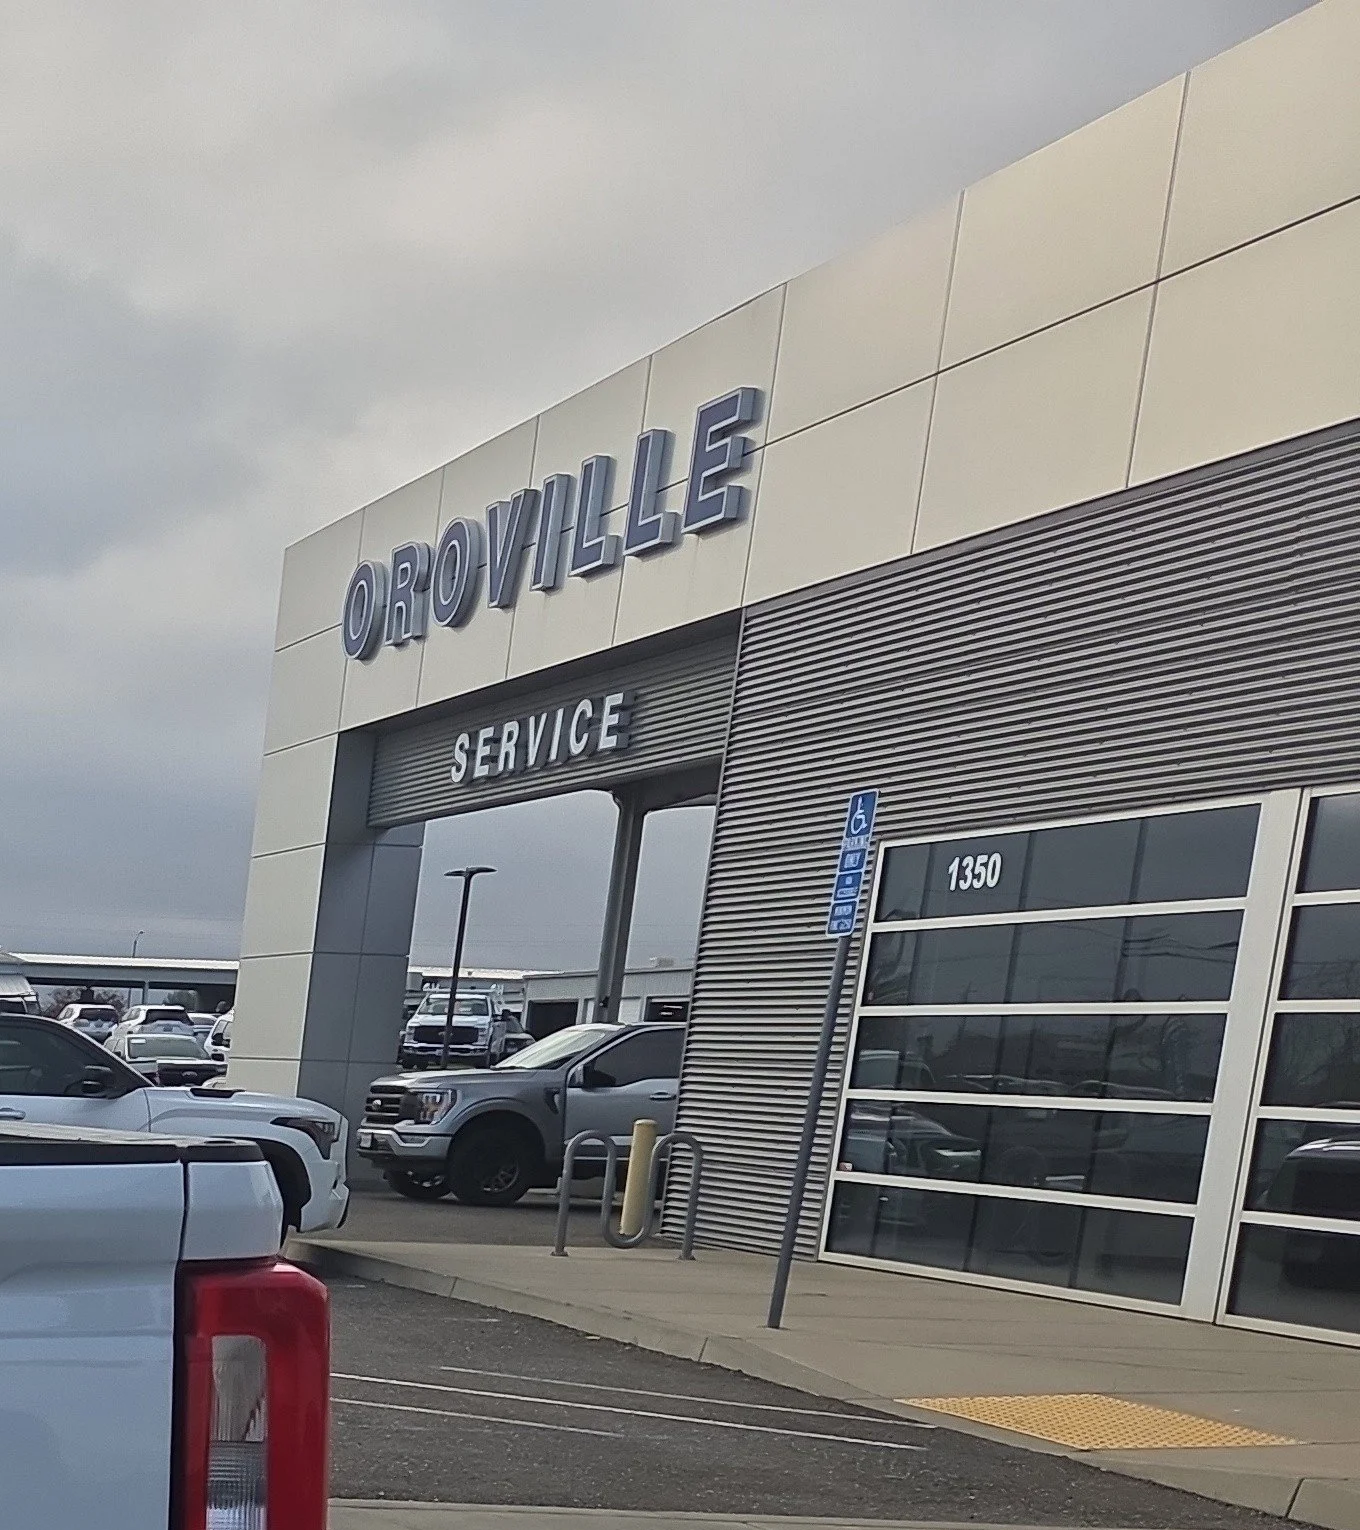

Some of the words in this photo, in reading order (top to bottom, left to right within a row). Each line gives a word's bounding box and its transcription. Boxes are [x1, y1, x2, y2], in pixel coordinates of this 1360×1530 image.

[342, 387, 762, 660] OROVILLE
[450, 692, 626, 783] SERVICE
[947, 852, 1002, 892] 1350
